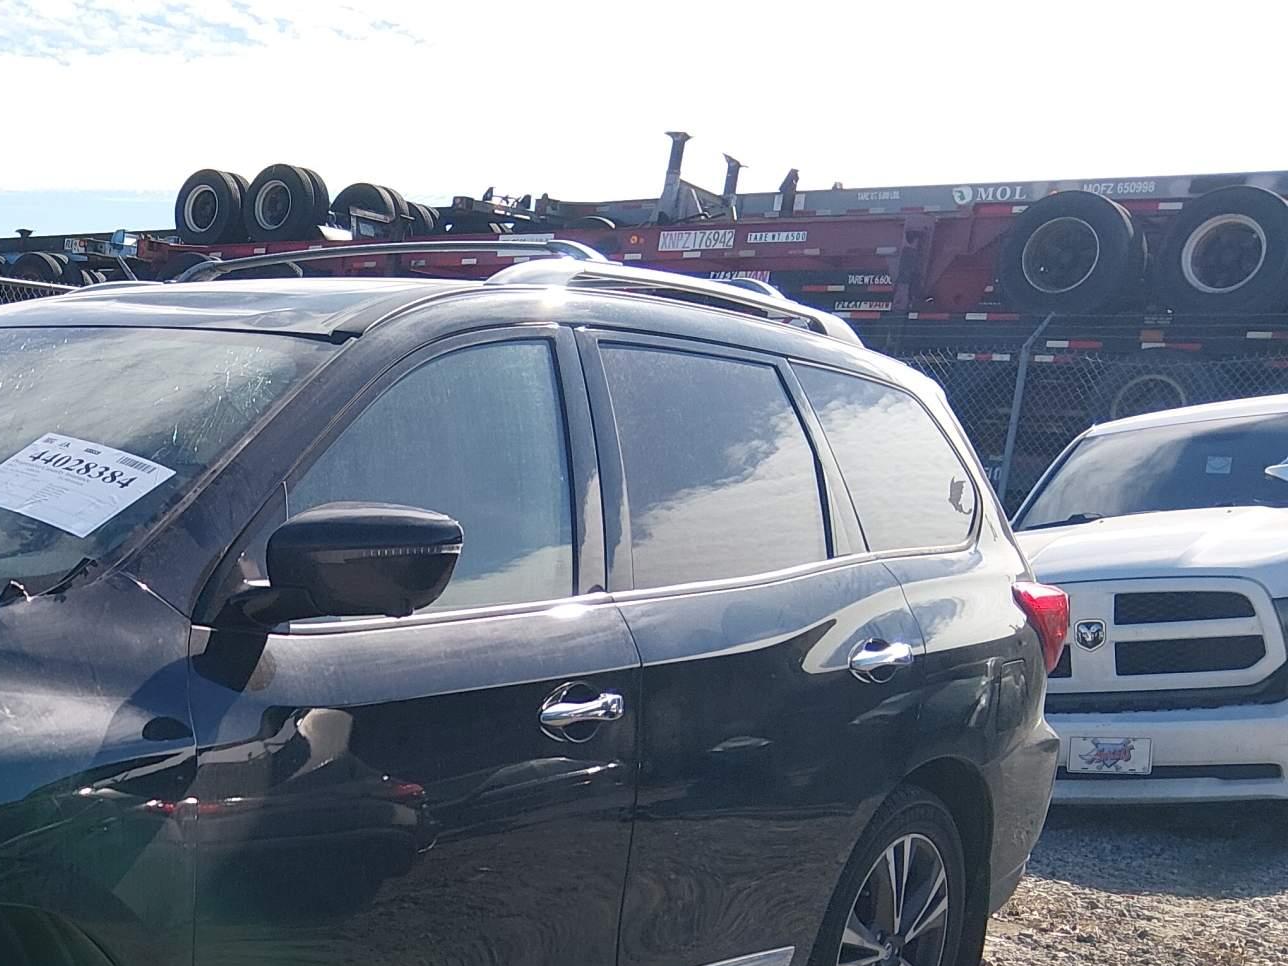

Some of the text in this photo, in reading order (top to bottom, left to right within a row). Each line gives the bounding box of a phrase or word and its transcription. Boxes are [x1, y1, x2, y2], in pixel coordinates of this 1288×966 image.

[976, 186, 1027, 201] MOL
[749, 232, 768, 242] TARE
[785, 231, 807, 241] 6500
[29, 450, 138, 489] 44028384
